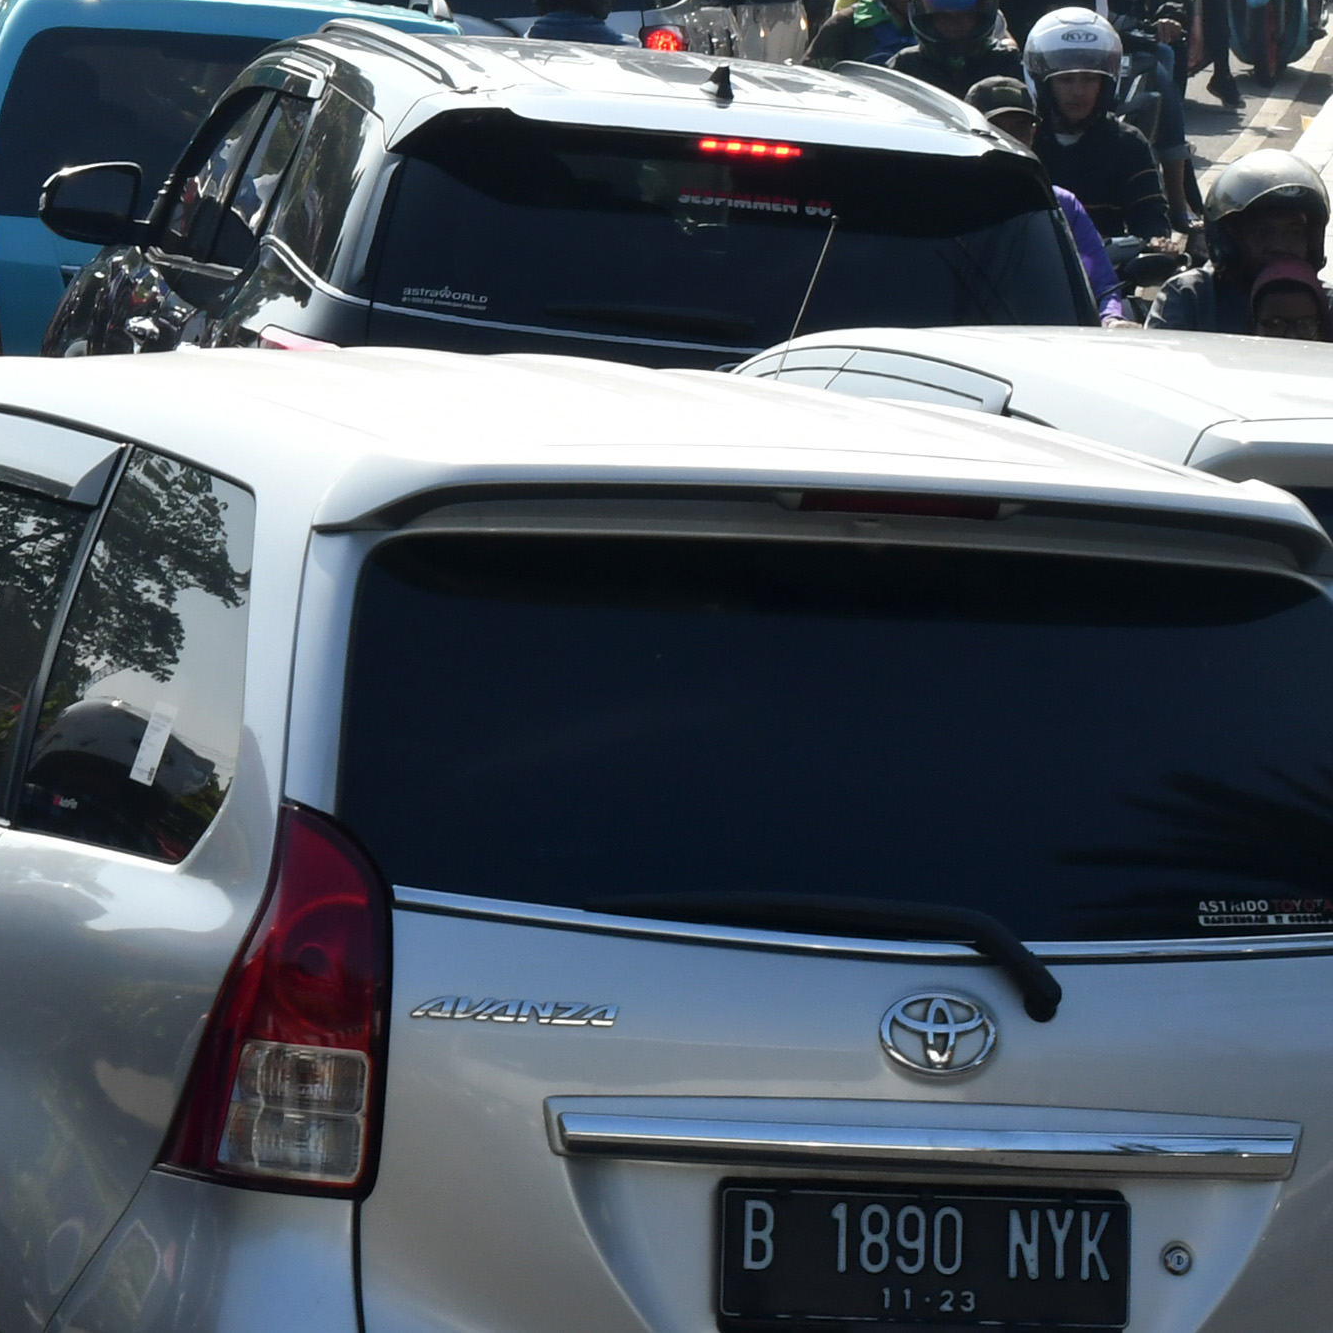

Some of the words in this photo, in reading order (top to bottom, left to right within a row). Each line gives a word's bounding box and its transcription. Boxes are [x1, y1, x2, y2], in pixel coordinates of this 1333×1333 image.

[1199, 899, 1269, 912] ASTRIDO
[1269, 898, 1332, 912] TOYOTA
[410, 995, 620, 1027] AVANZA
[743, 1199, 775, 1270] B
[831, 1203, 964, 1275] 1890
[1008, 1208, 1112, 1282] NYK
